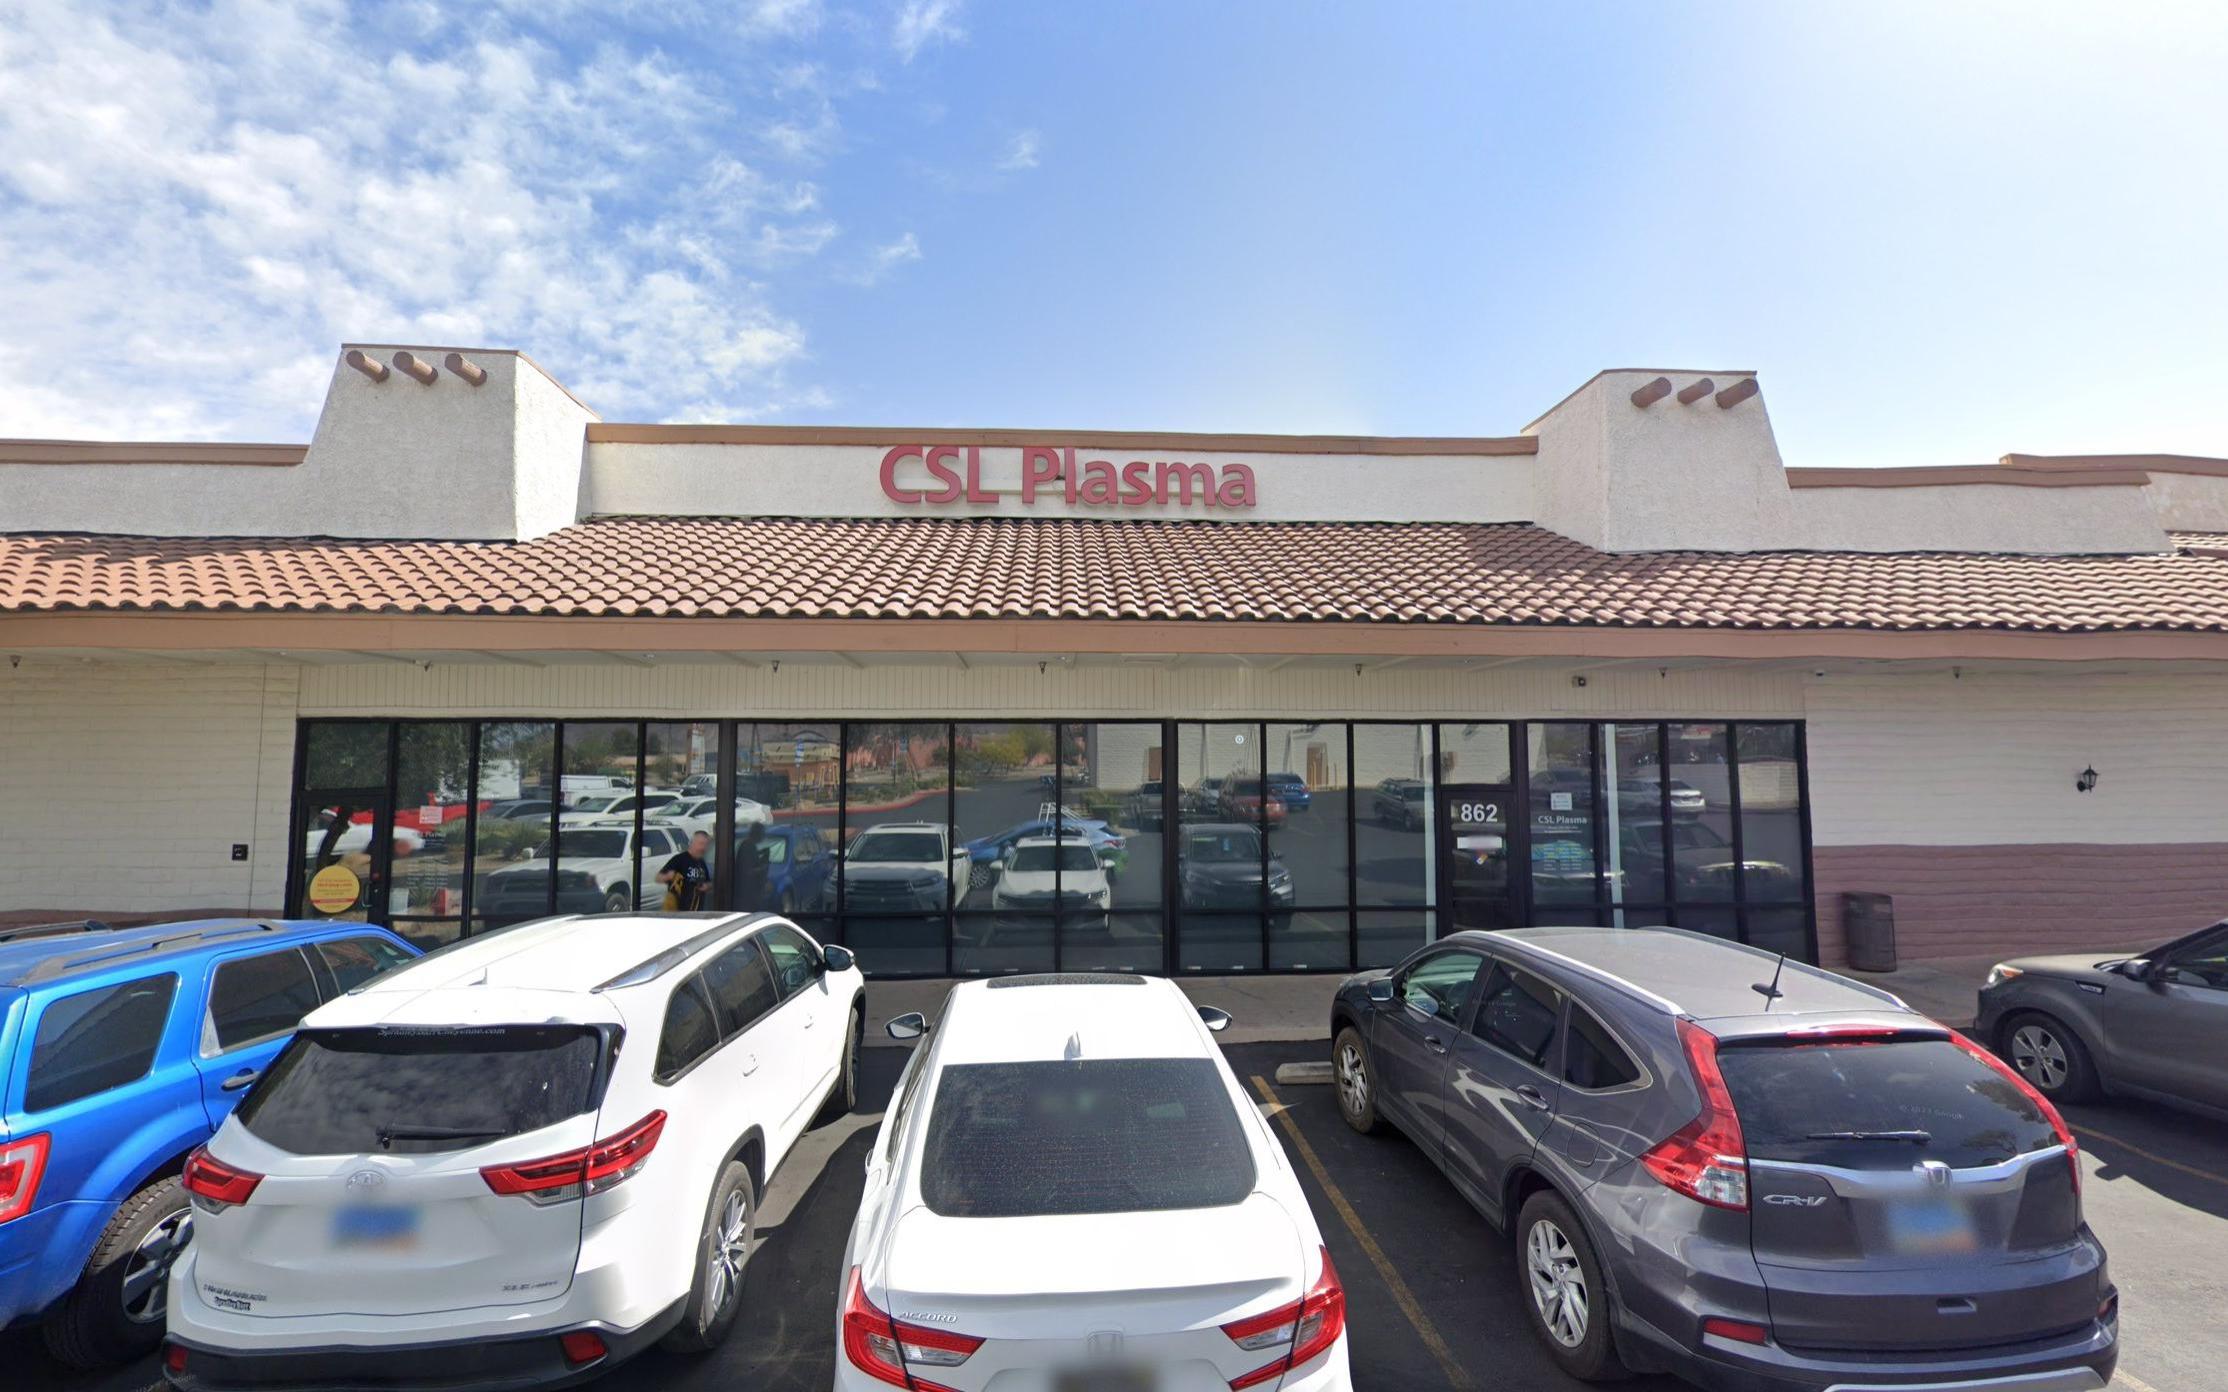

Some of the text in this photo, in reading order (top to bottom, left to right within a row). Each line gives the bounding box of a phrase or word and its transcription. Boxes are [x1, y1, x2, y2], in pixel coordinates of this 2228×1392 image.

[880, 444, 1257, 506] CSL Plasma
[1461, 803, 1498, 822] 862
[1538, 815, 1588, 825] CSL Plasma
[1762, 1194, 1828, 1207] CR-V
[899, 1311, 959, 1323] ACCORD
